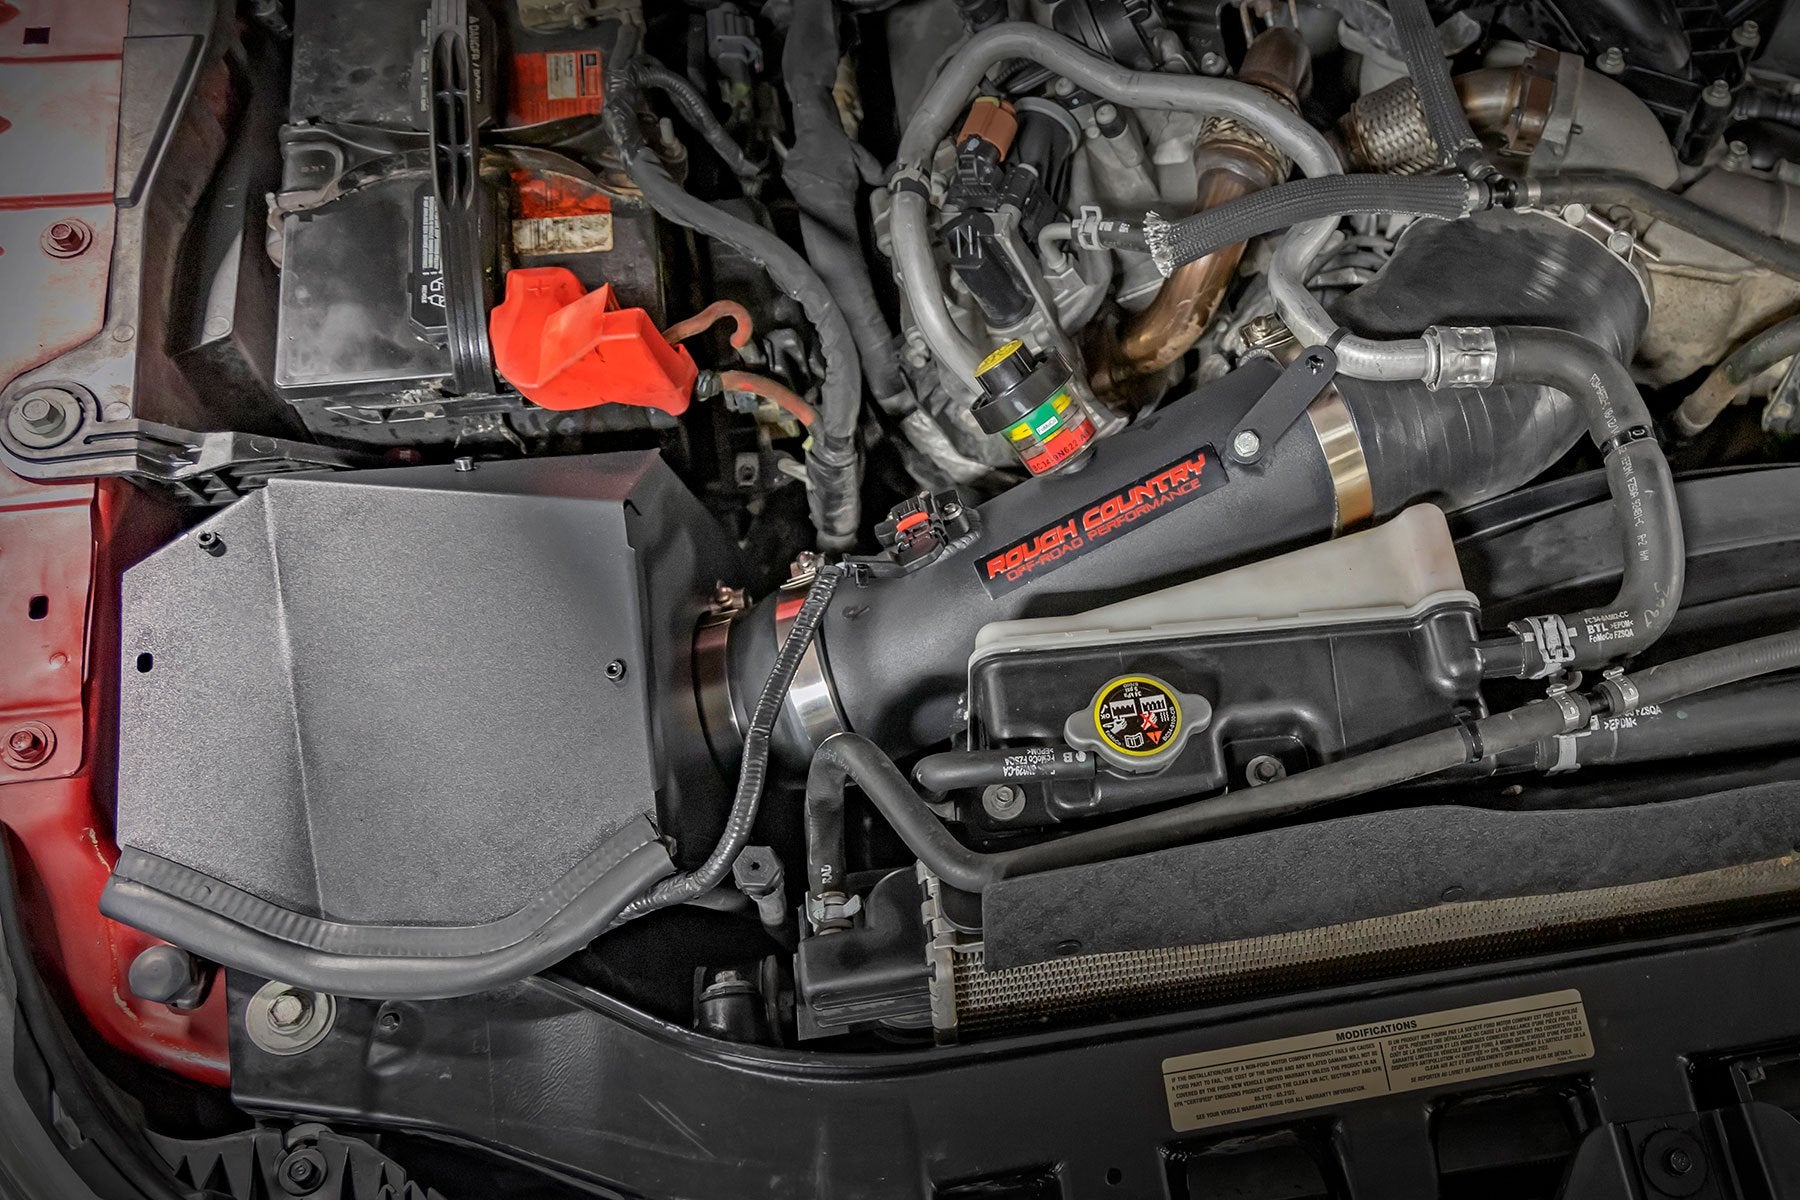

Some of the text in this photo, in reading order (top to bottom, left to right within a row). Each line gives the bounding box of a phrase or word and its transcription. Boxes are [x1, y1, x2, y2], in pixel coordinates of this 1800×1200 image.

[986, 453, 1206, 579] ROUGH COUNTRY
[1007, 478, 1201, 582] OFF-ROAD PERFORMANCE
[1586, 623, 1608, 634] BTL
[1589, 632, 1614, 643] FoMoCo
[1063, 752, 1073, 763] B
[1336, 1019, 1417, 1041] MODIFICATIONS
[1245, 1061, 1269, 1069] NON-FORD
[1288, 1054, 1311, 1062] COMPANY
[1306, 1059, 1327, 1067] RELATED
[1176, 1090, 1198, 1098] COVERED
[1284, 1070, 1310, 1079] WARRANTY
[1340, 1061, 1362, 1069] PRODUCT
[1214, 1090, 1241, 1100] EMISSIONS
[1241, 1086, 1264, 1095] PRODUCT
[1220, 1107, 1240, 1115] VEHICLE
[1240, 1102, 1268, 1112] WARRANTY
[1304, 1091, 1331, 1100] WARRANTY
[1332, 1085, 1366, 1095] INFORMATION.
